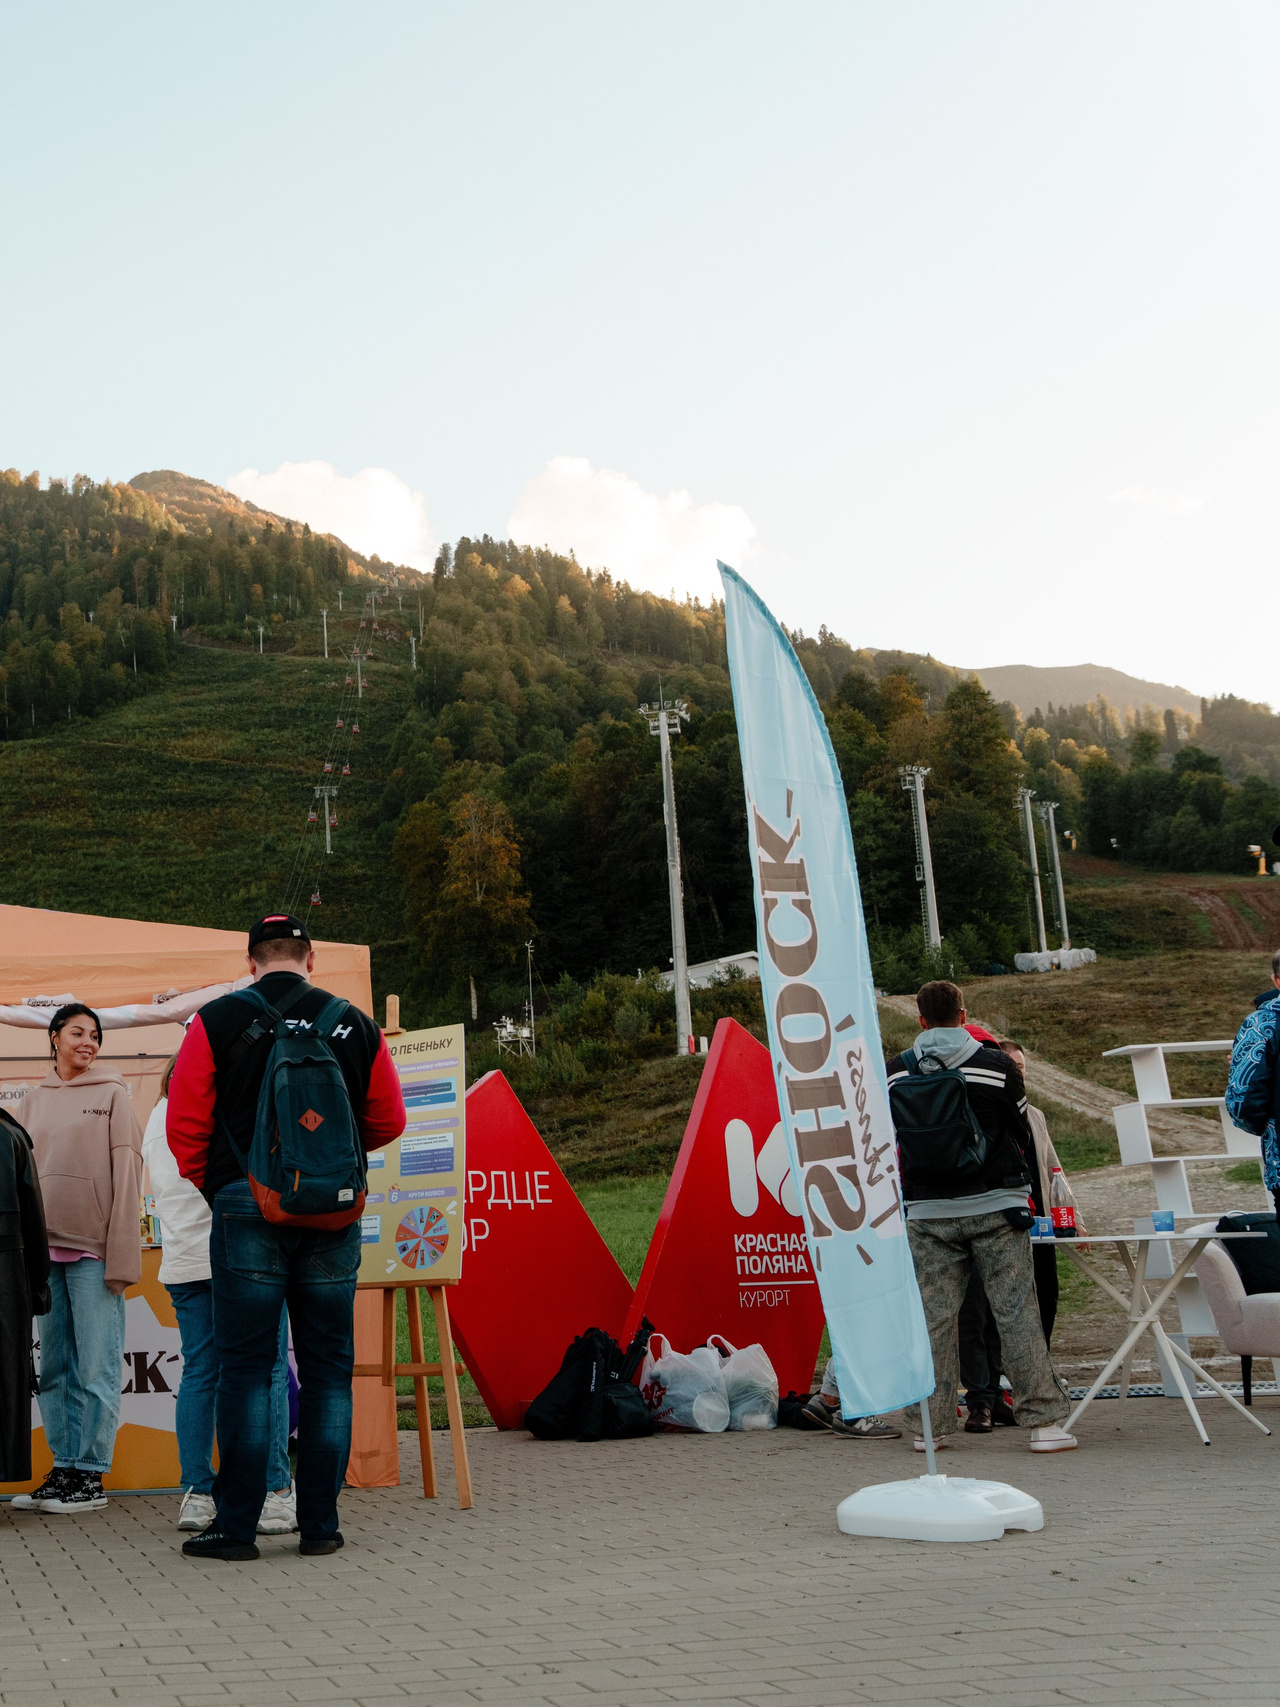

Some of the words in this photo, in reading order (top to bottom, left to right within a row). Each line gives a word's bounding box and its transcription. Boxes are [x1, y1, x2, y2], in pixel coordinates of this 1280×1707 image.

[399, 1038, 453, 1055] ПЕЧЕНЬКУ
[391, 1192, 398, 1202] 6
[408, 1191, 425, 1199] КРУТИ
[425, 1189, 445, 1197] КОЛЕСО
[464, 1170, 553, 1211] РДЦЕ
[1060, 1208, 1068, 1226] Rich
[734, 1233, 809, 1254] КРАСНАЯ
[736, 1254, 809, 1275] ПОЛЯНА
[739, 1290, 791, 1308] КУРОРТ
